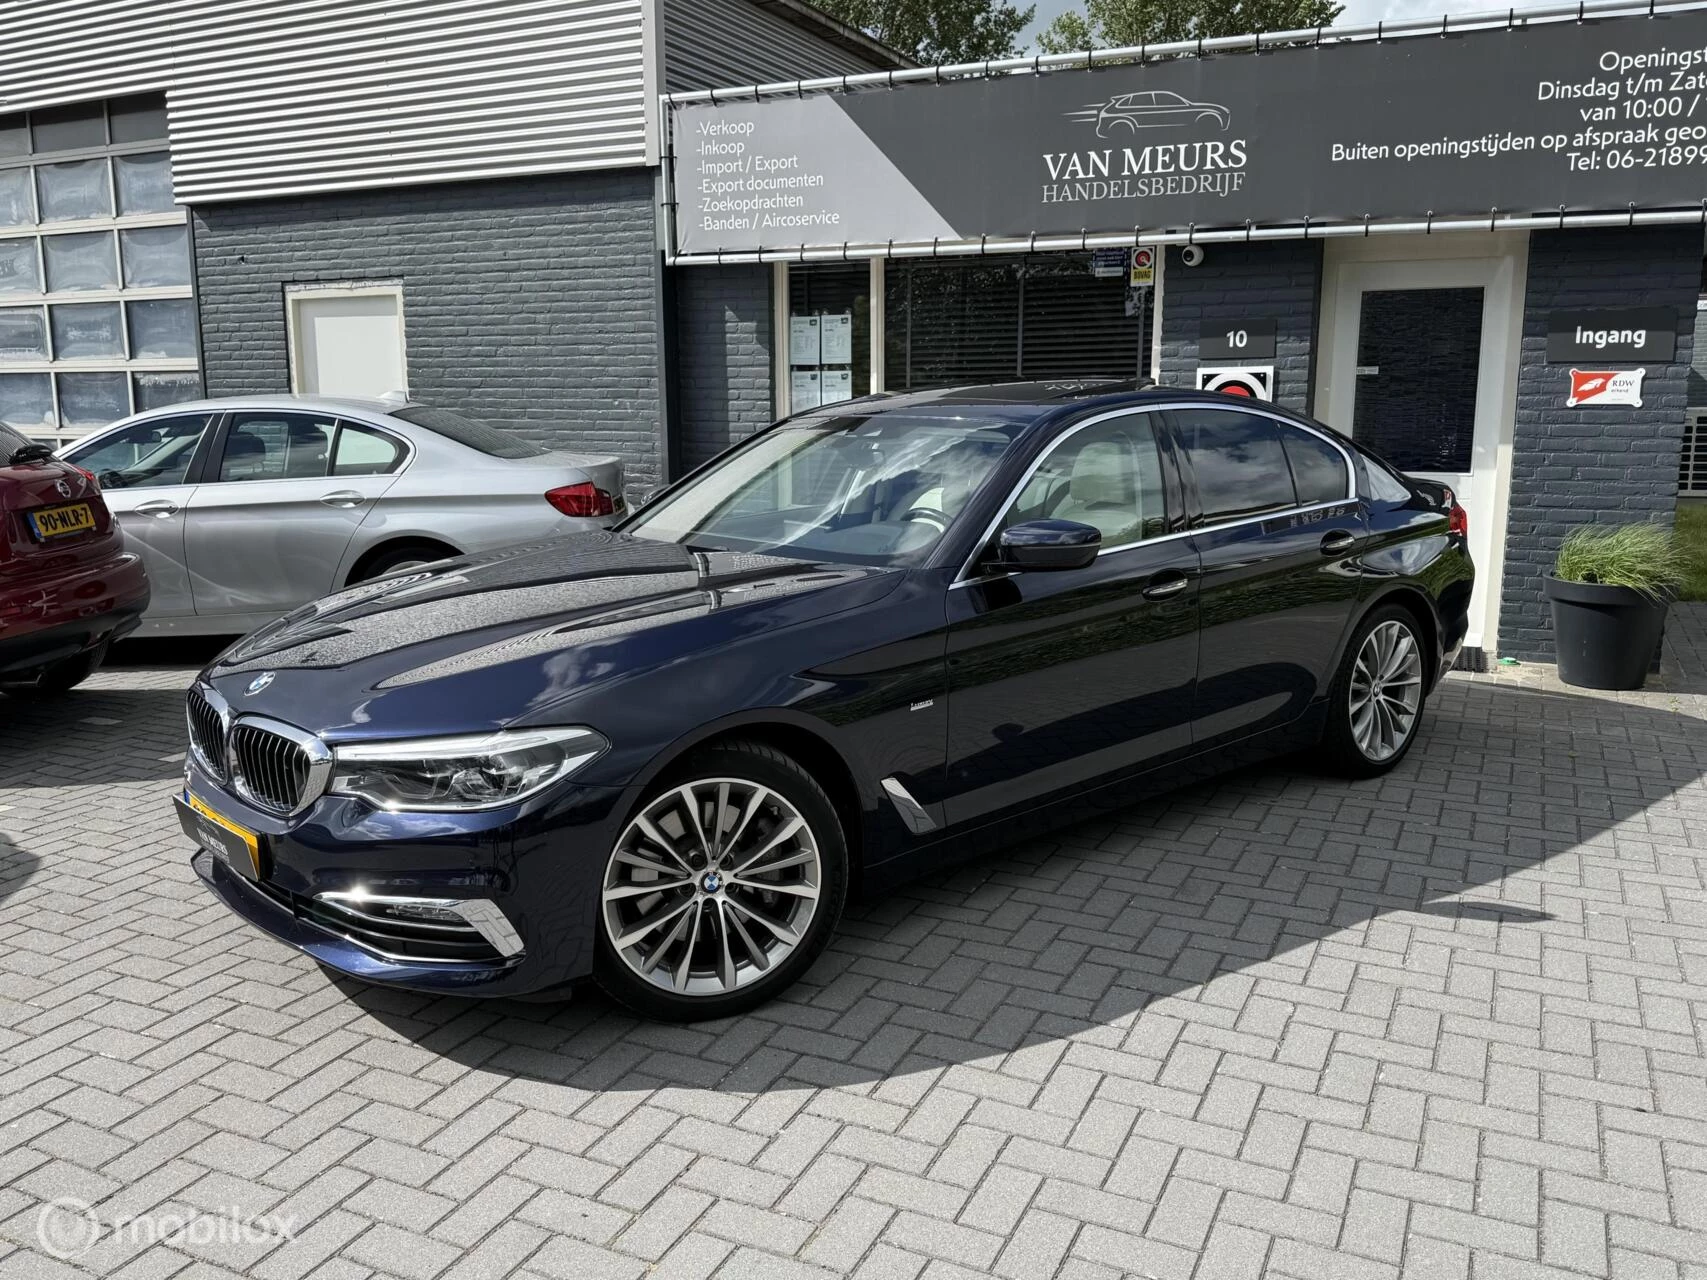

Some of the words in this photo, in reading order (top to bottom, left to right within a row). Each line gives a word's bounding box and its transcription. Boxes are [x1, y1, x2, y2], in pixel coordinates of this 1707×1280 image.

[1538, 77, 1620, 100] Dinsdag
[1626, 72, 1663, 96] t/m
[1669, 71, 1707, 92] Zat
[1580, 106, 1616, 121] van
[1623, 96, 1682, 119] 10:00
[696, 119, 754, 136] -Verkoop
[696, 140, 745, 157] -Inkoop
[1331, 142, 1389, 161] Buiten
[1394, 131, 1535, 161] openingstijden
[1540, 134, 1567, 153] op
[1572, 123, 1660, 151] afspraak
[1665, 126, 1707, 147] geo
[697, 159, 743, 177] -Import
[746, 155, 752, 174] /
[755, 155, 799, 174] Export
[1043, 149, 1113, 181] VAN
[1121, 139, 1248, 176] MEURS
[1566, 150, 1601, 171] Tel:
[1606, 145, 1707, 169] 06-21899
[698, 178, 744, 197] -Export
[746, 173, 824, 191] documenten
[1041, 171, 1246, 203] HANDELSBEDRIJF
[698, 193, 804, 213] -Zoekopdrachten
[699, 214, 750, 231] -Banden
[752, 213, 759, 230] /
[762, 210, 840, 228] Aircoservice
[1226, 330, 1248, 348] 10
[1575, 325, 1646, 349] Ingang
[39, 507, 89, 532] 90-NLR-7
